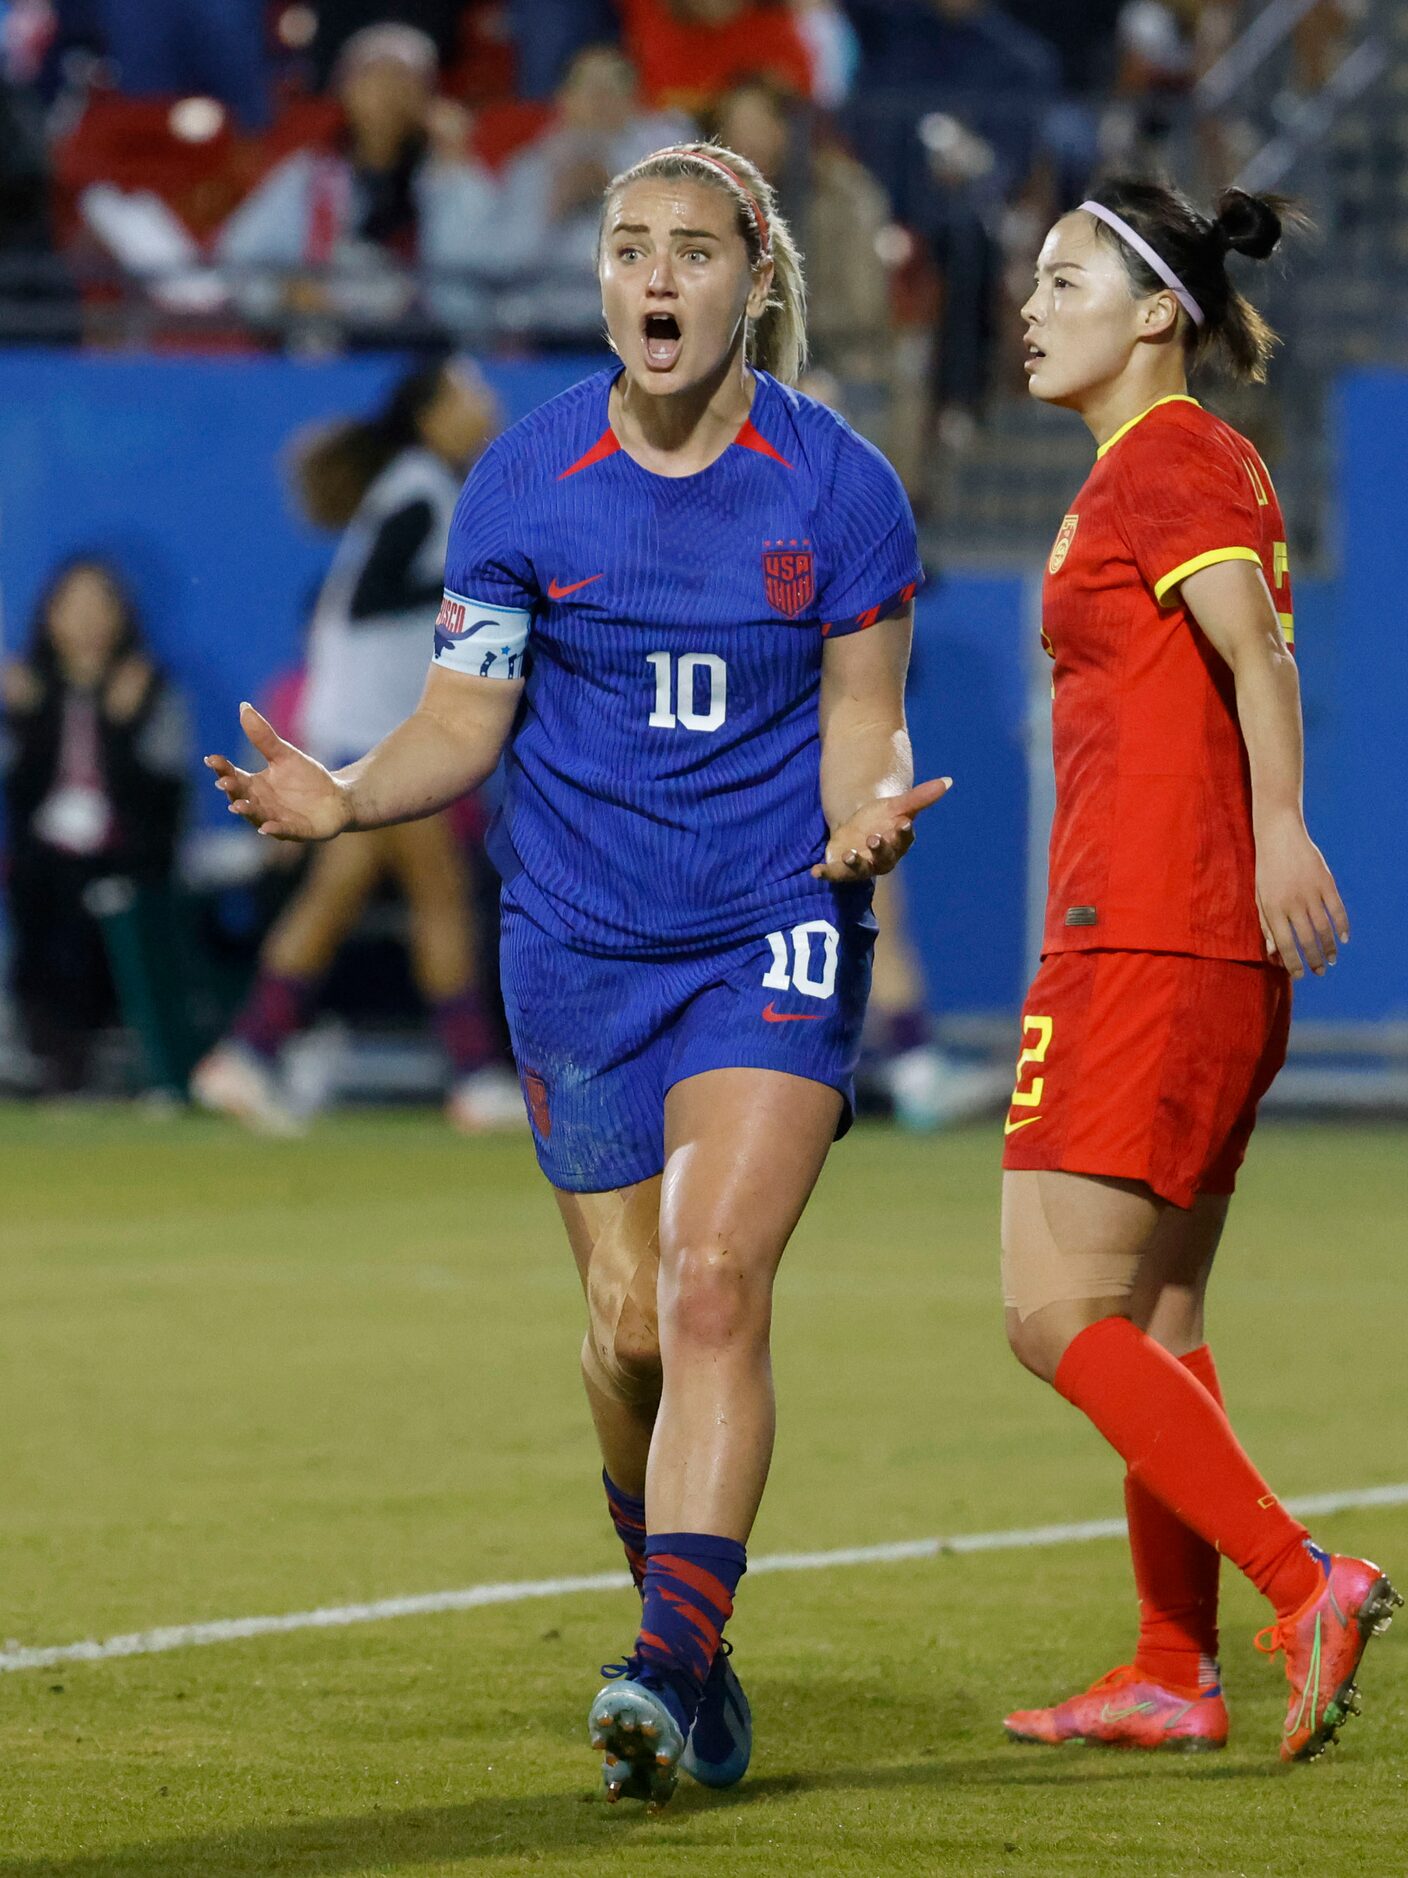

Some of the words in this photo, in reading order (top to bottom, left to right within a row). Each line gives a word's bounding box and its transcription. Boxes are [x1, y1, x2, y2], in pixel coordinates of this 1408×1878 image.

[766, 555, 809, 580] USA
[646, 651, 727, 732] 10
[762, 919, 840, 999] 10
[1011, 1015, 1053, 1107] 2
